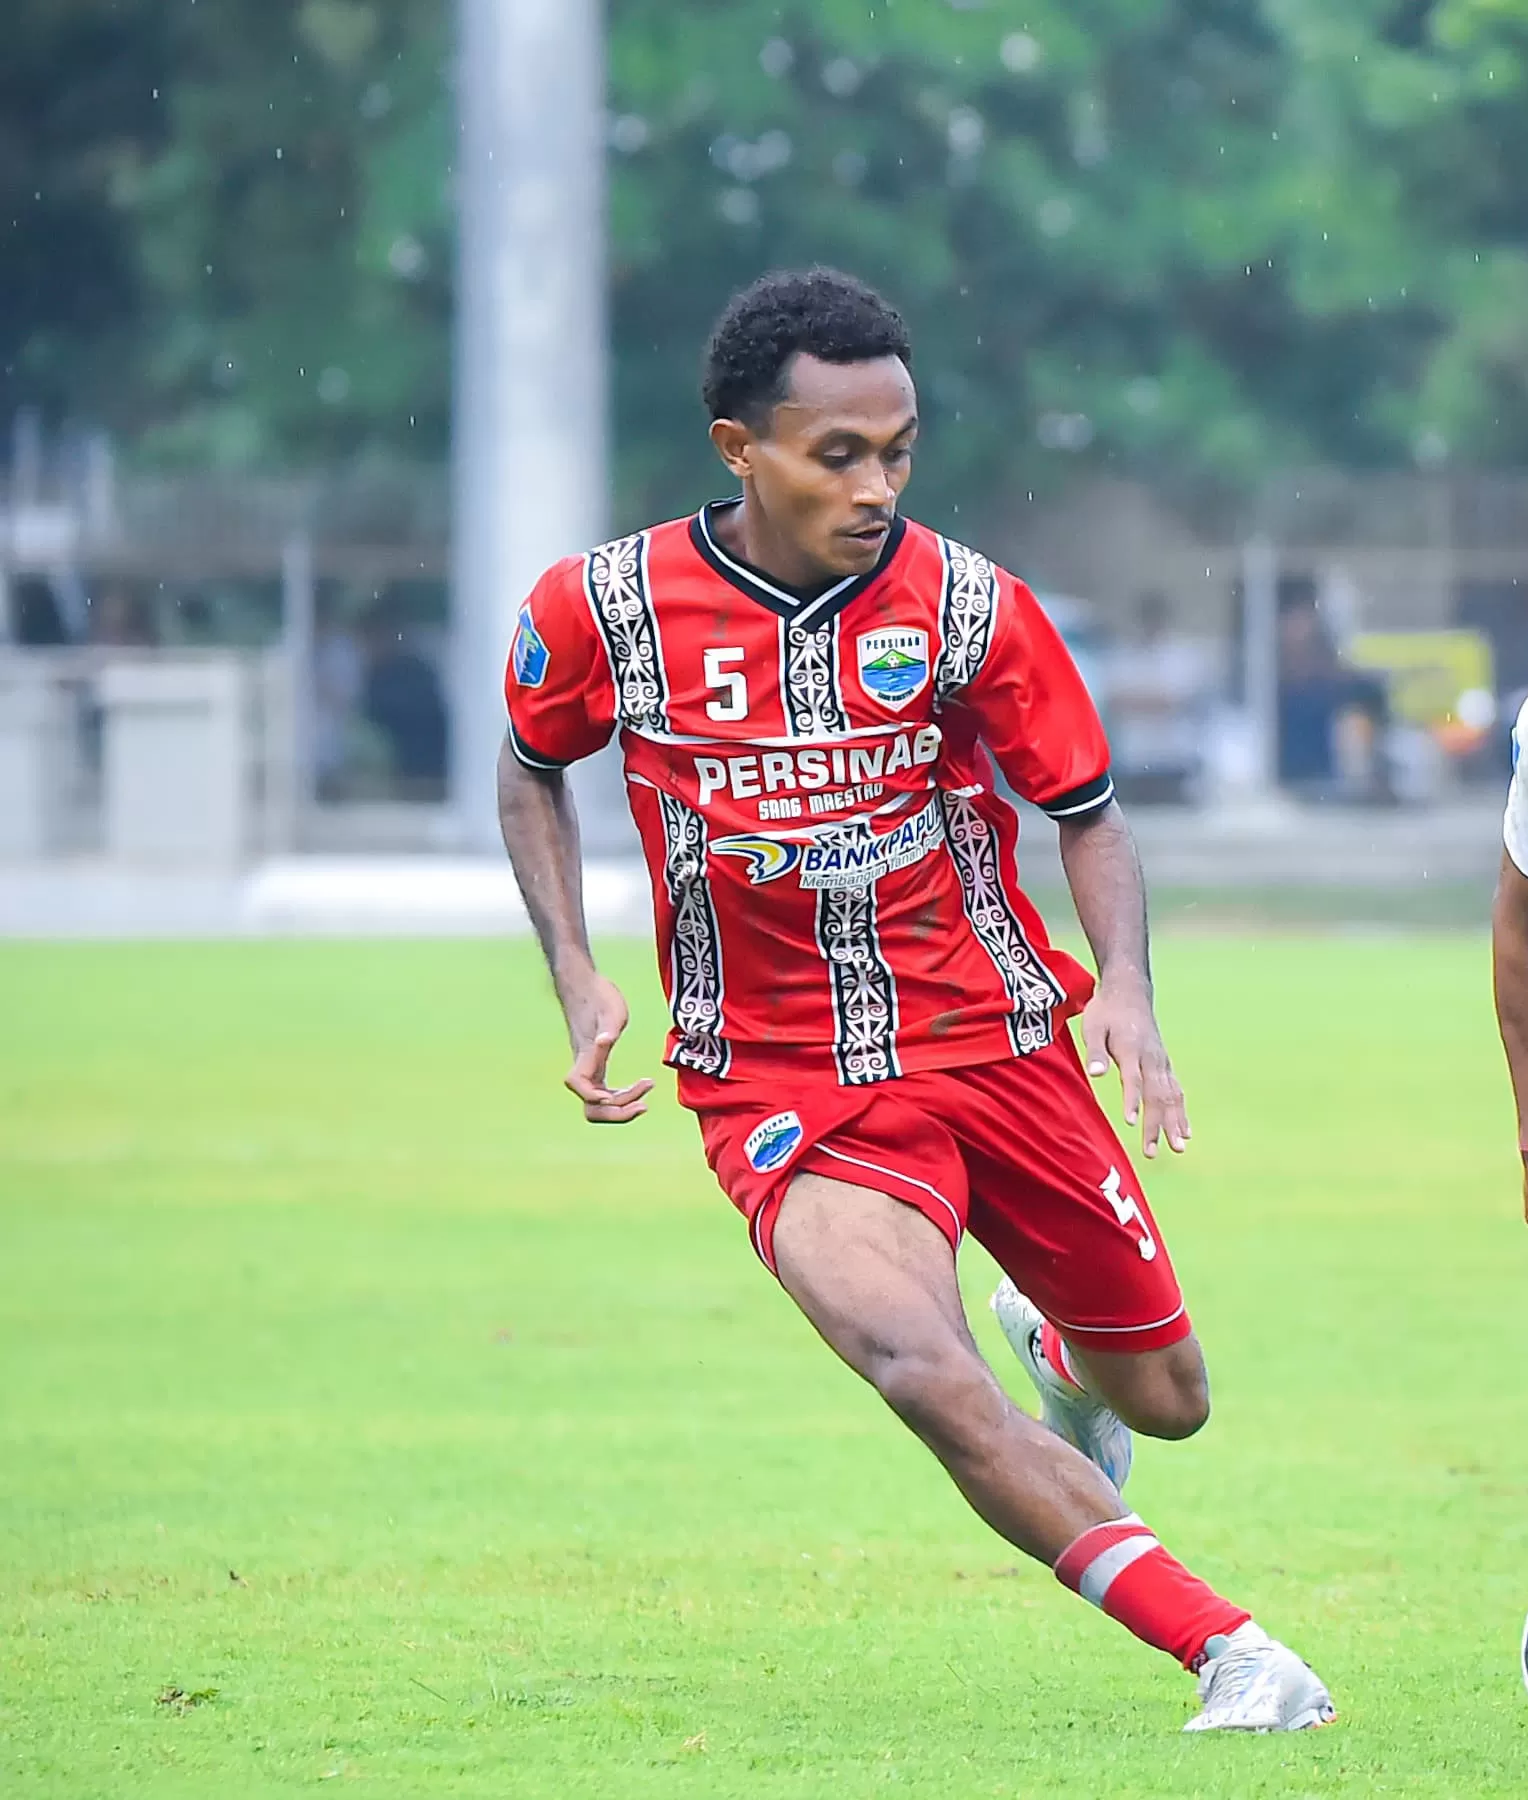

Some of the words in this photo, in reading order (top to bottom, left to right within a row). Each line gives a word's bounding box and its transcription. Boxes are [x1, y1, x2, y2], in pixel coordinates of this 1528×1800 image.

[703, 647, 748, 721] 5
[693, 723, 942, 806] PERSINAB
[758, 798, 802, 820] SANG
[808, 783, 884, 815] MAESTRO
[802, 863, 886, 888] Membangun
[805, 837, 884, 872] BANK
[1098, 1164, 1157, 1262] 5
